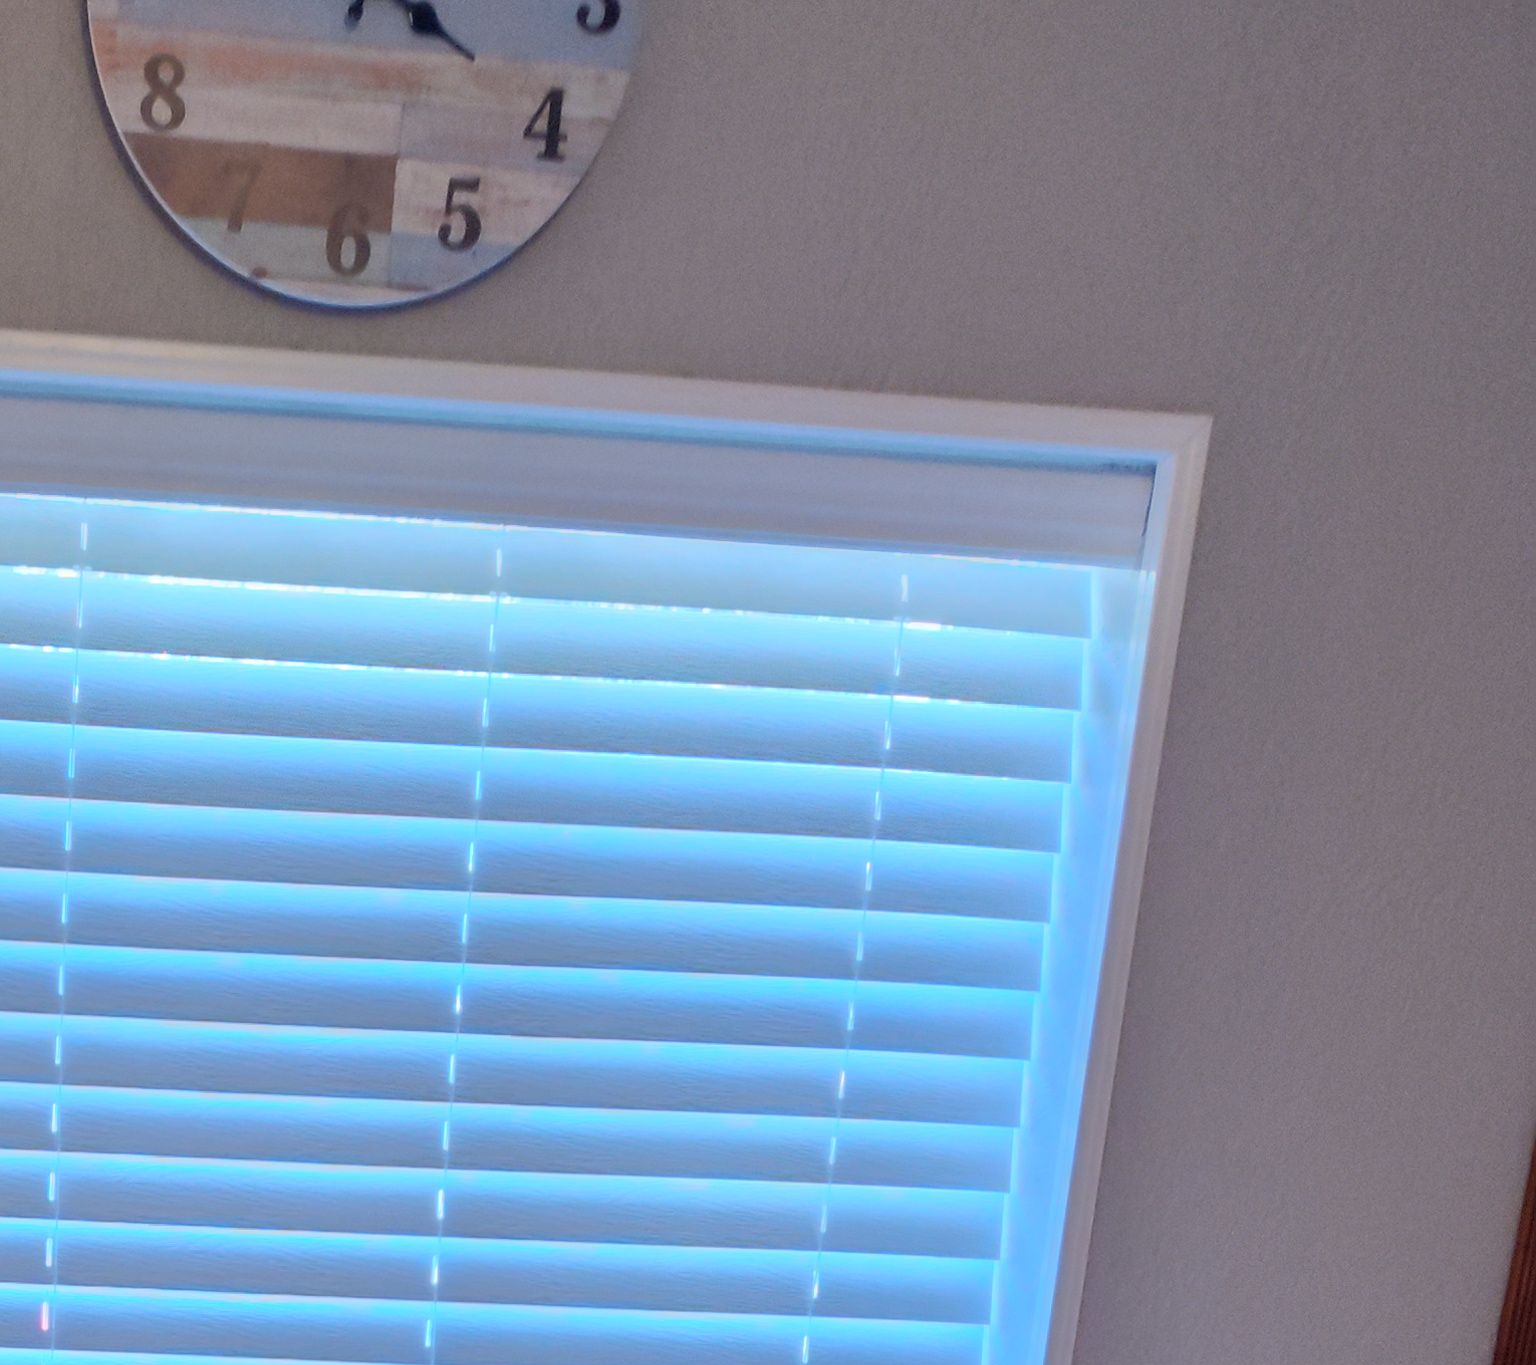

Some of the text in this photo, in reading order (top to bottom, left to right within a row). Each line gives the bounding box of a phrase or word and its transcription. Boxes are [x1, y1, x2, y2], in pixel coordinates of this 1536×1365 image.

[139, 53, 186, 132] 8
[522, 86, 568, 161] 4
[222, 156, 263, 233] 7
[436, 176, 482, 252] 5
[324, 200, 371, 277] 6
